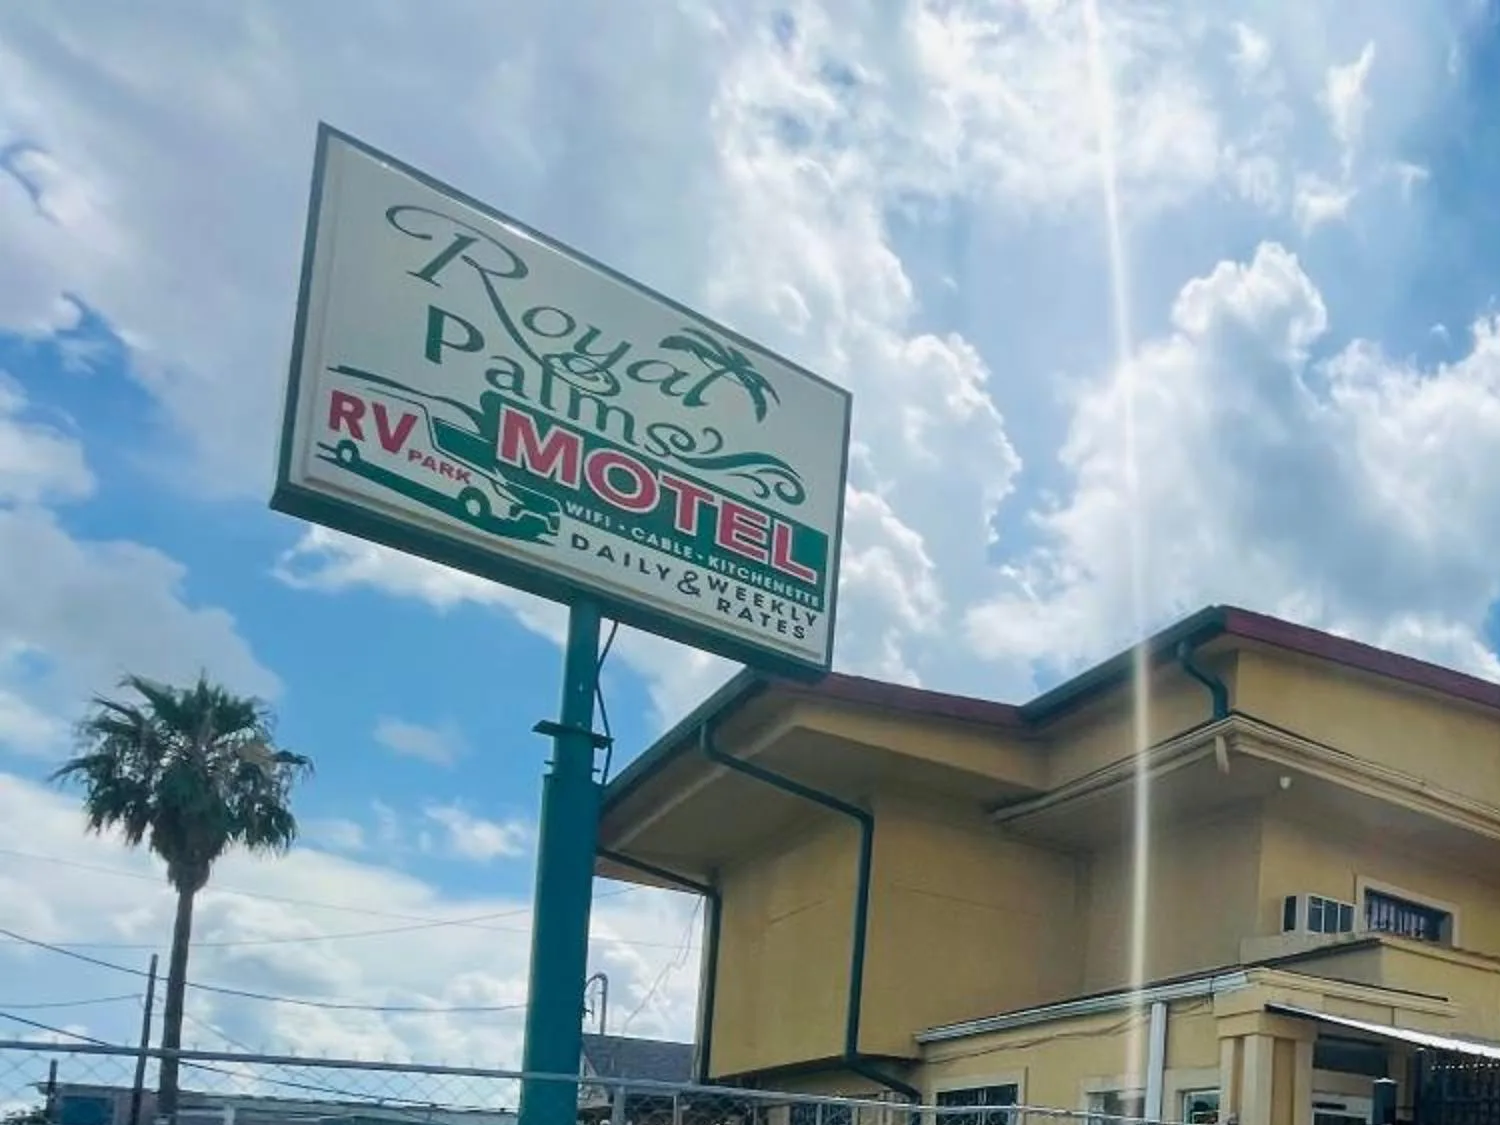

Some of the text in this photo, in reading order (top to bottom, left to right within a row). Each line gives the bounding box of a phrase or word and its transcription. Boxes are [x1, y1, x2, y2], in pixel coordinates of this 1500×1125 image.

[385, 204, 765, 412] Royal
[424, 304, 700, 459] Palms
[329, 390, 418, 454] RV
[408, 449, 473, 484] PARK
[498, 406, 817, 585] MOTEL
[565, 500, 611, 527] WIFI
[631, 527, 694, 559] CABLE
[572, 534, 701, 597] DAILY &
[707, 574, 818, 627] WEEKLY
[717, 597, 806, 640] RATES
